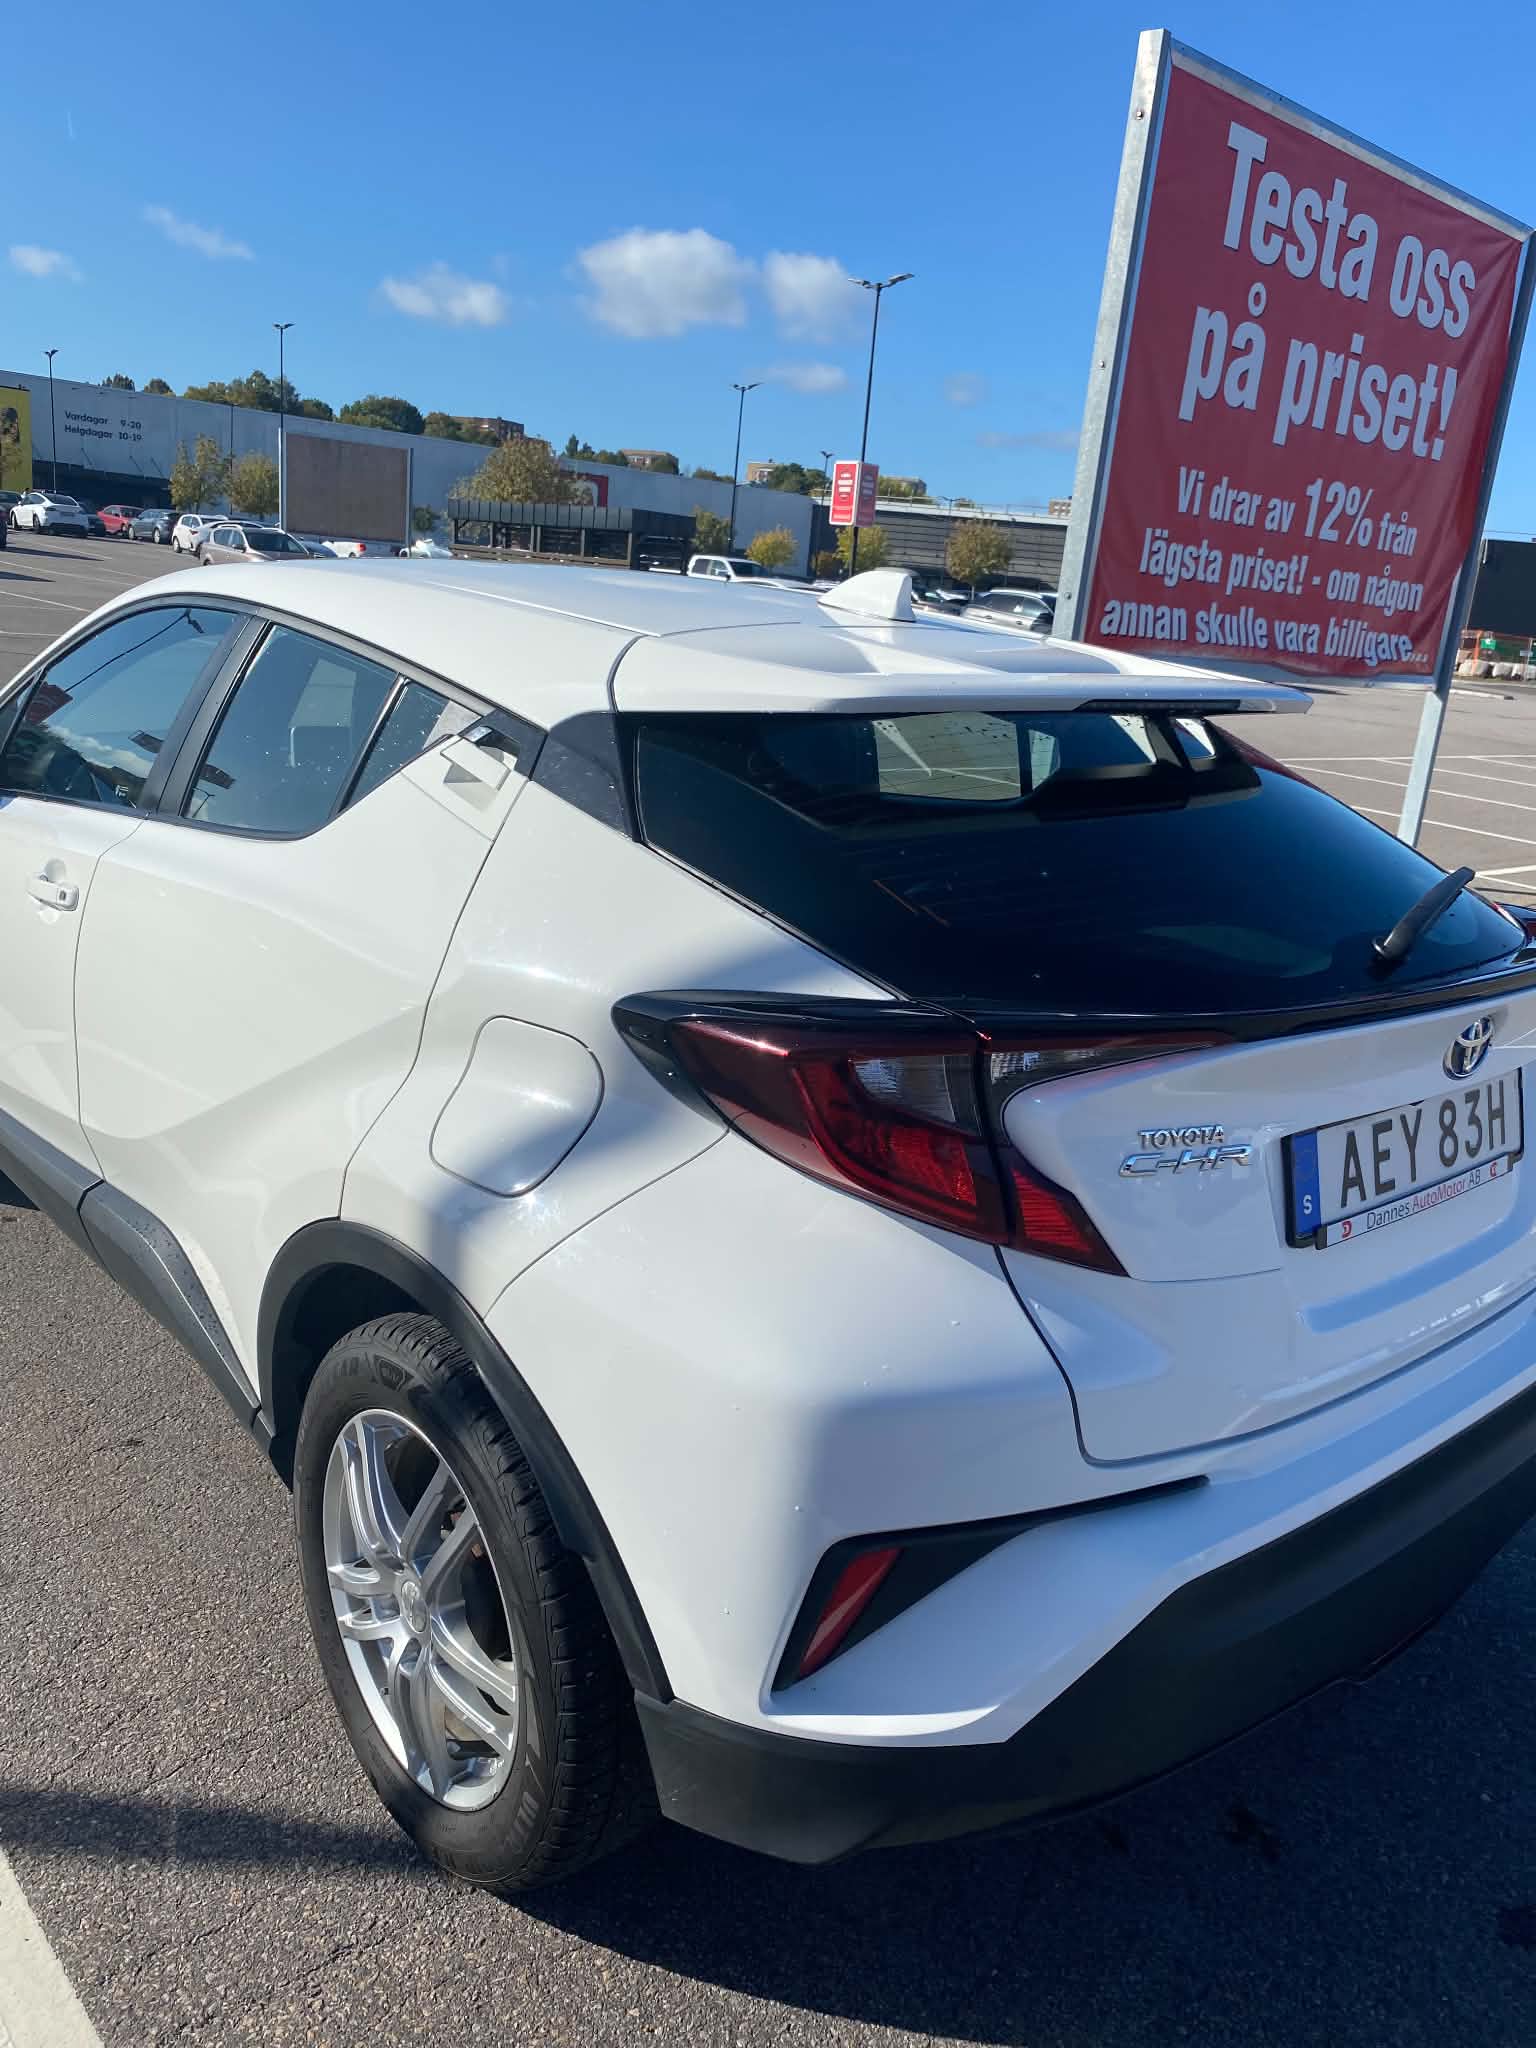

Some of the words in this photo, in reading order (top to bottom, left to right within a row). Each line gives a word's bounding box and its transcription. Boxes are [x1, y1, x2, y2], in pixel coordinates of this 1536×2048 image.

[1223, 121, 1379, 301] Testa
[1389, 235, 1476, 338] oss
[1178, 282, 1267, 421] på
[1272, 332, 1458, 461] priset!
[64, 425, 112, 438] Helgdagar
[65, 411, 108, 424] Vardagar
[1178, 465, 1205, 517] Vi
[1209, 476, 1261, 526] drar
[1265, 498, 1297, 534] av
[1304, 477, 1374, 548] 12%
[1377, 511, 1418, 557] från
[1139, 527, 1222, 586] lägsta
[1226, 547, 1309, 595] priset!
[1326, 567, 1361, 603] om
[1363, 564, 1424, 617] någon
[1101, 600, 1187, 640] annan
[1195, 602, 1268, 649] skulle
[1274, 620, 1320, 656] vara
[1118, 1143, 1253, 1178] C-HR
[1140, 1123, 1225, 1150] TOYOTA
[1340, 1109, 1423, 1209] AEY
[1438, 1080, 1506, 1169] 83H
[1303, 1194, 1313, 1215] S
[1366, 1201, 1411, 1229] Dannes
[1412, 1179, 1466, 1211] AutoMotor
[1469, 1169, 1481, 1188] AB
